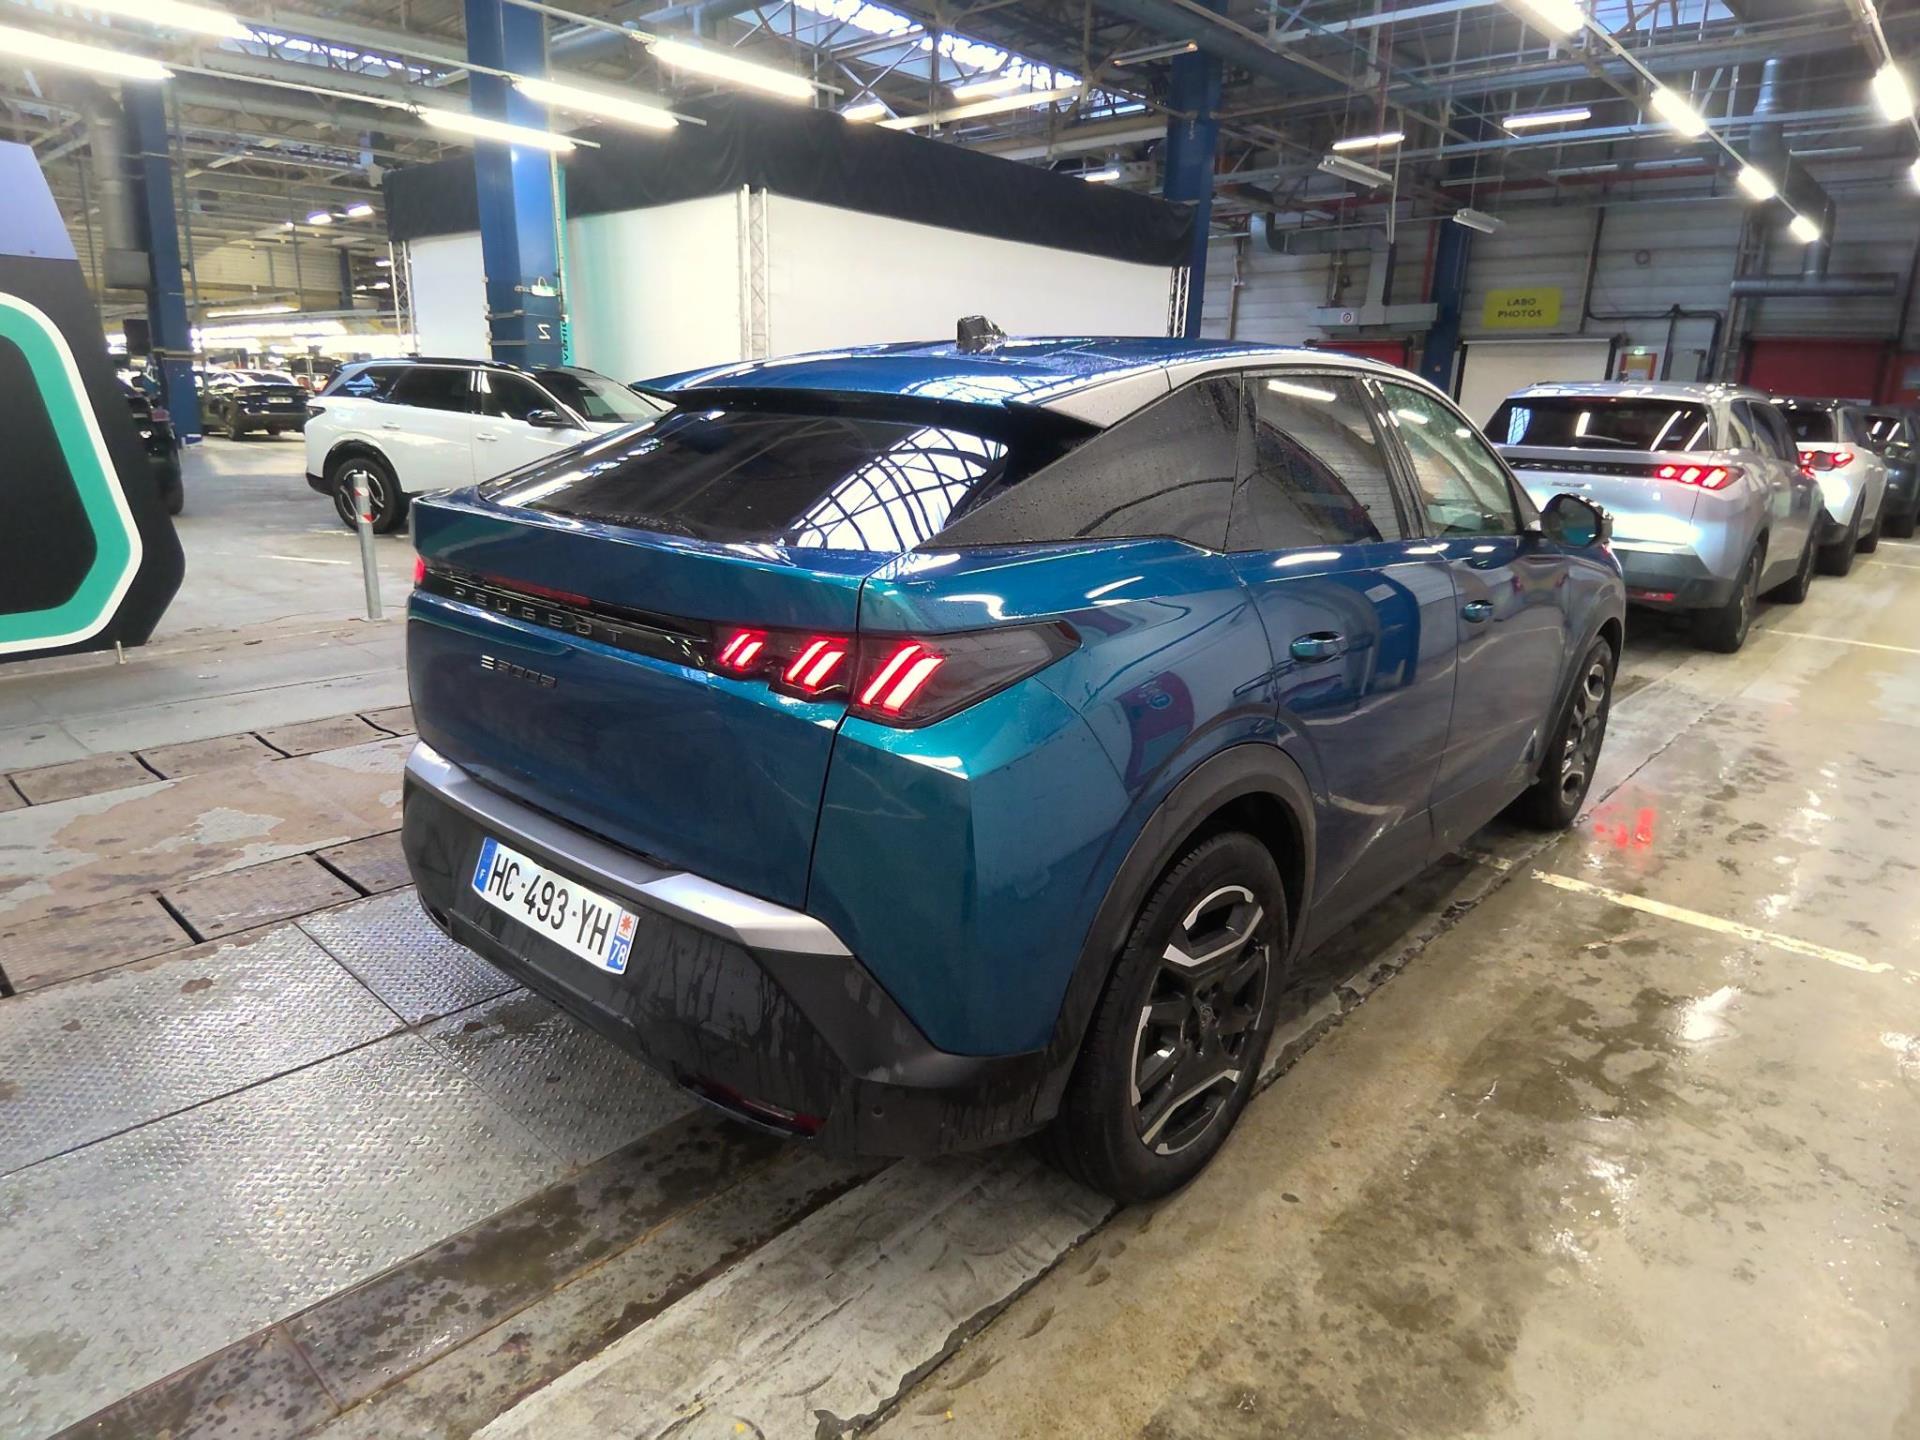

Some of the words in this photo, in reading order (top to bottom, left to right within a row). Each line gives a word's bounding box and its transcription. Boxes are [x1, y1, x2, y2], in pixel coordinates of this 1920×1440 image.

[1506, 298, 1537, 307] LABO
[1497, 309, 1543, 318] PHOTOS
[453, 588, 626, 643] PEUGEOT
[478, 868, 486, 881] F
[610, 939, 628, 966] 78
